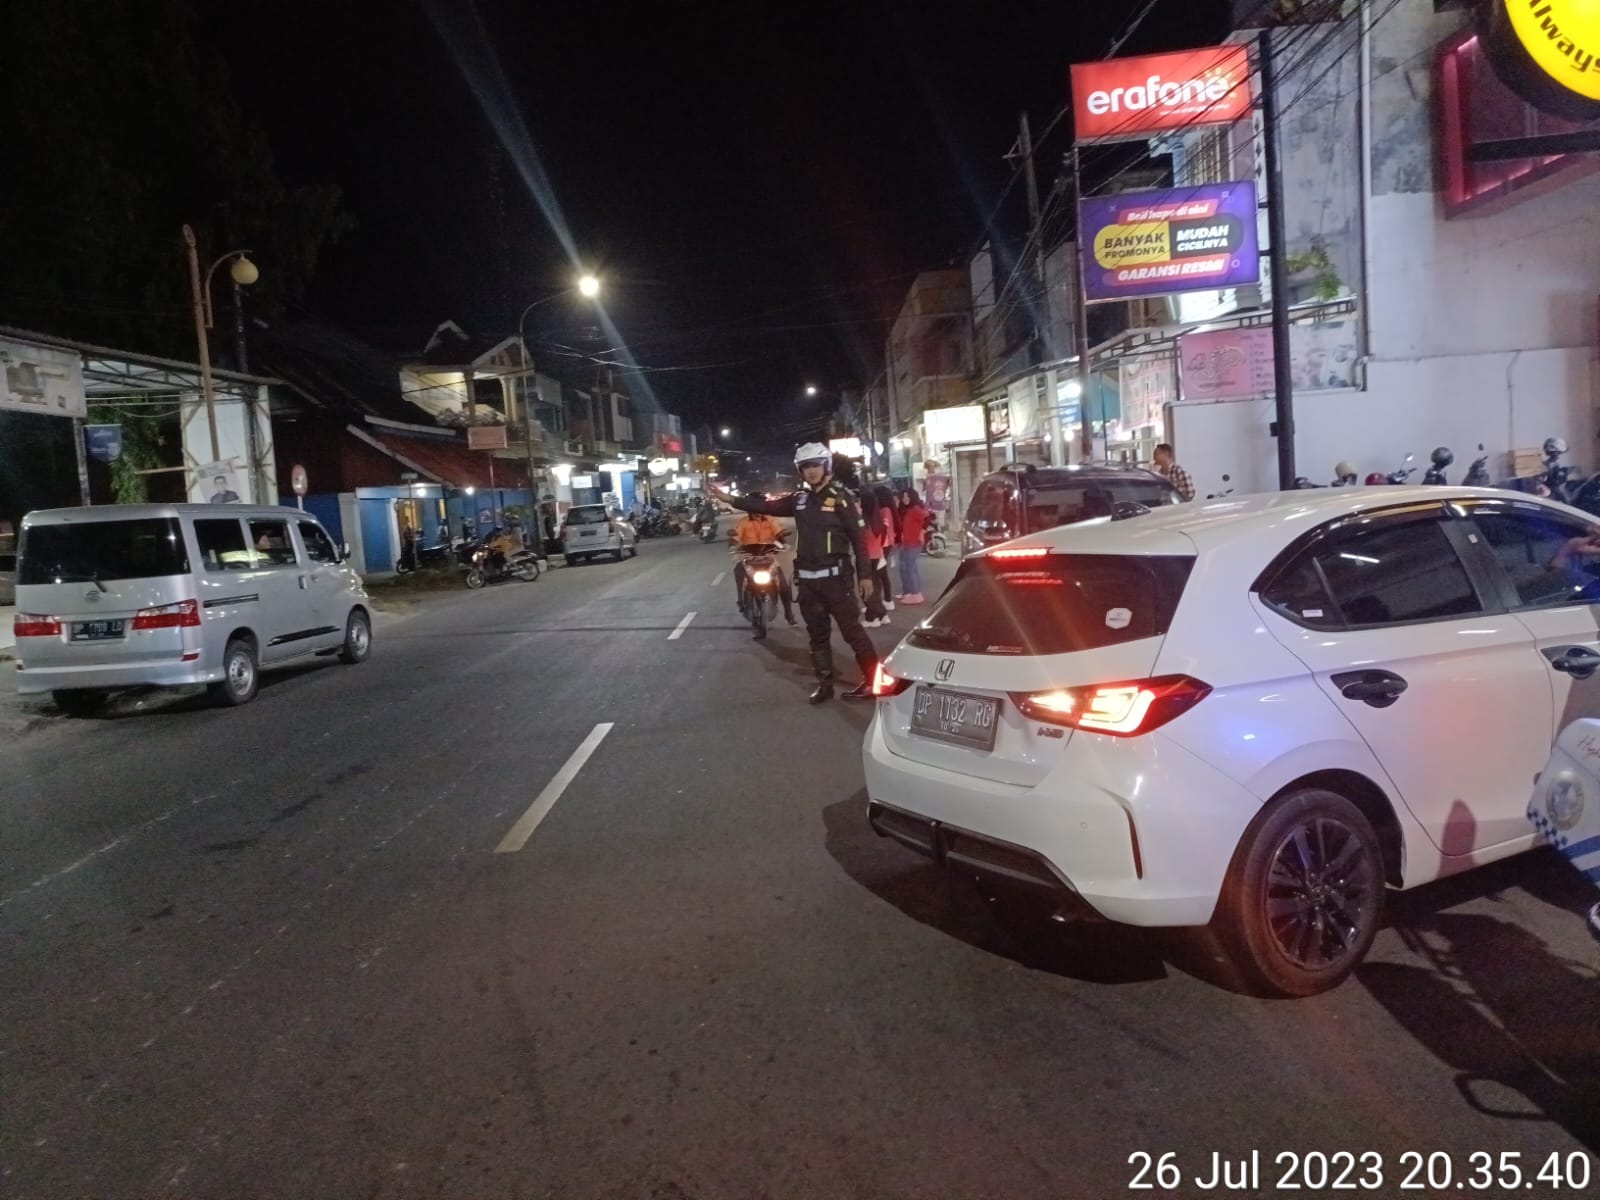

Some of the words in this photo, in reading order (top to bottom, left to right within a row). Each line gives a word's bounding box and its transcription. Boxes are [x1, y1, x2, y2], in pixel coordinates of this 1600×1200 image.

[1087, 74, 1229, 115] erafone
[1103, 231, 1164, 249] BANYAK
[1176, 225, 1229, 241] MUDAH
[1104, 245, 1165, 260] PROMONYA
[1118, 264, 1180, 281] GARANSI
[917, 692, 932, 715] DP
